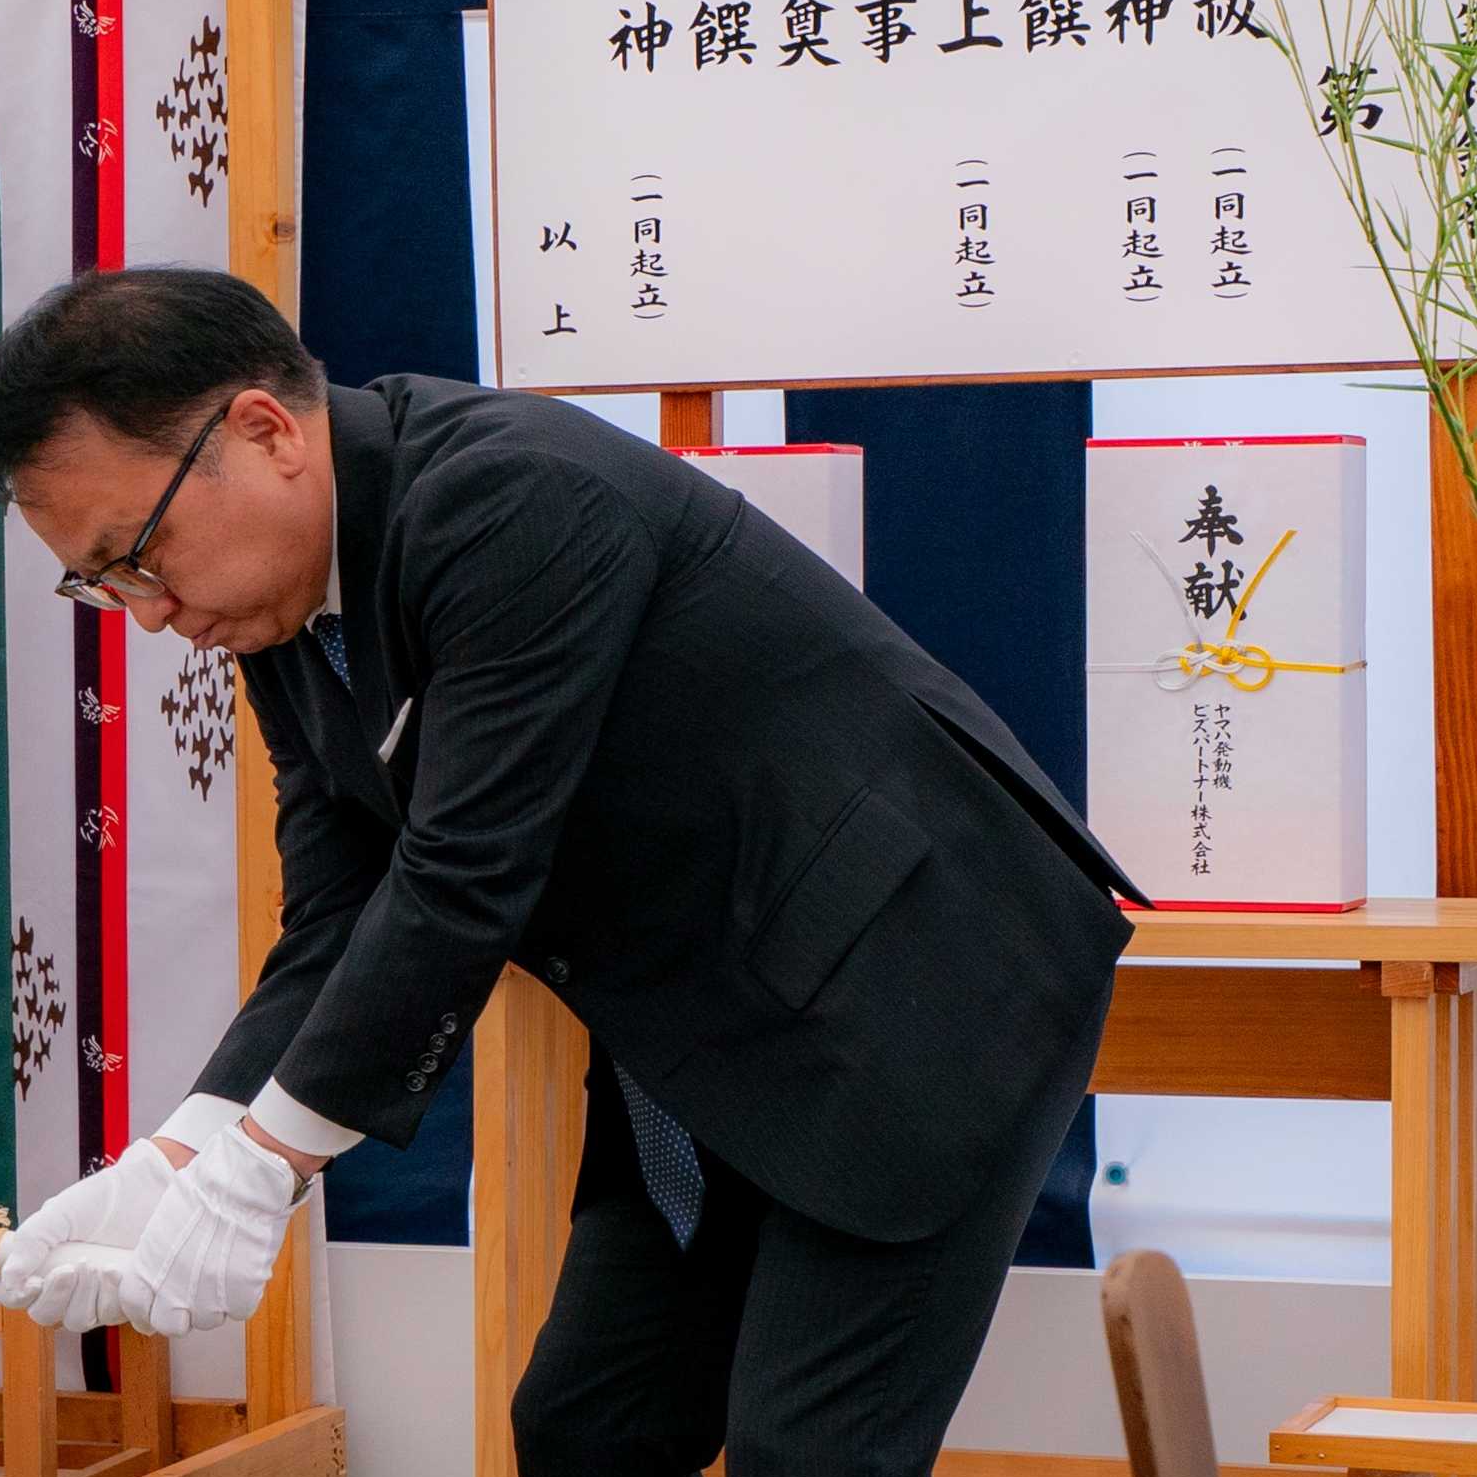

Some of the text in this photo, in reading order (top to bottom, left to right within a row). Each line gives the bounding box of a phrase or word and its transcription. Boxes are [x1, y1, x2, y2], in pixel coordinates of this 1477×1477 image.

[1178, 484, 1247, 621] 奉献
[1213, 703, 1234, 791] ヤマハ発動機
